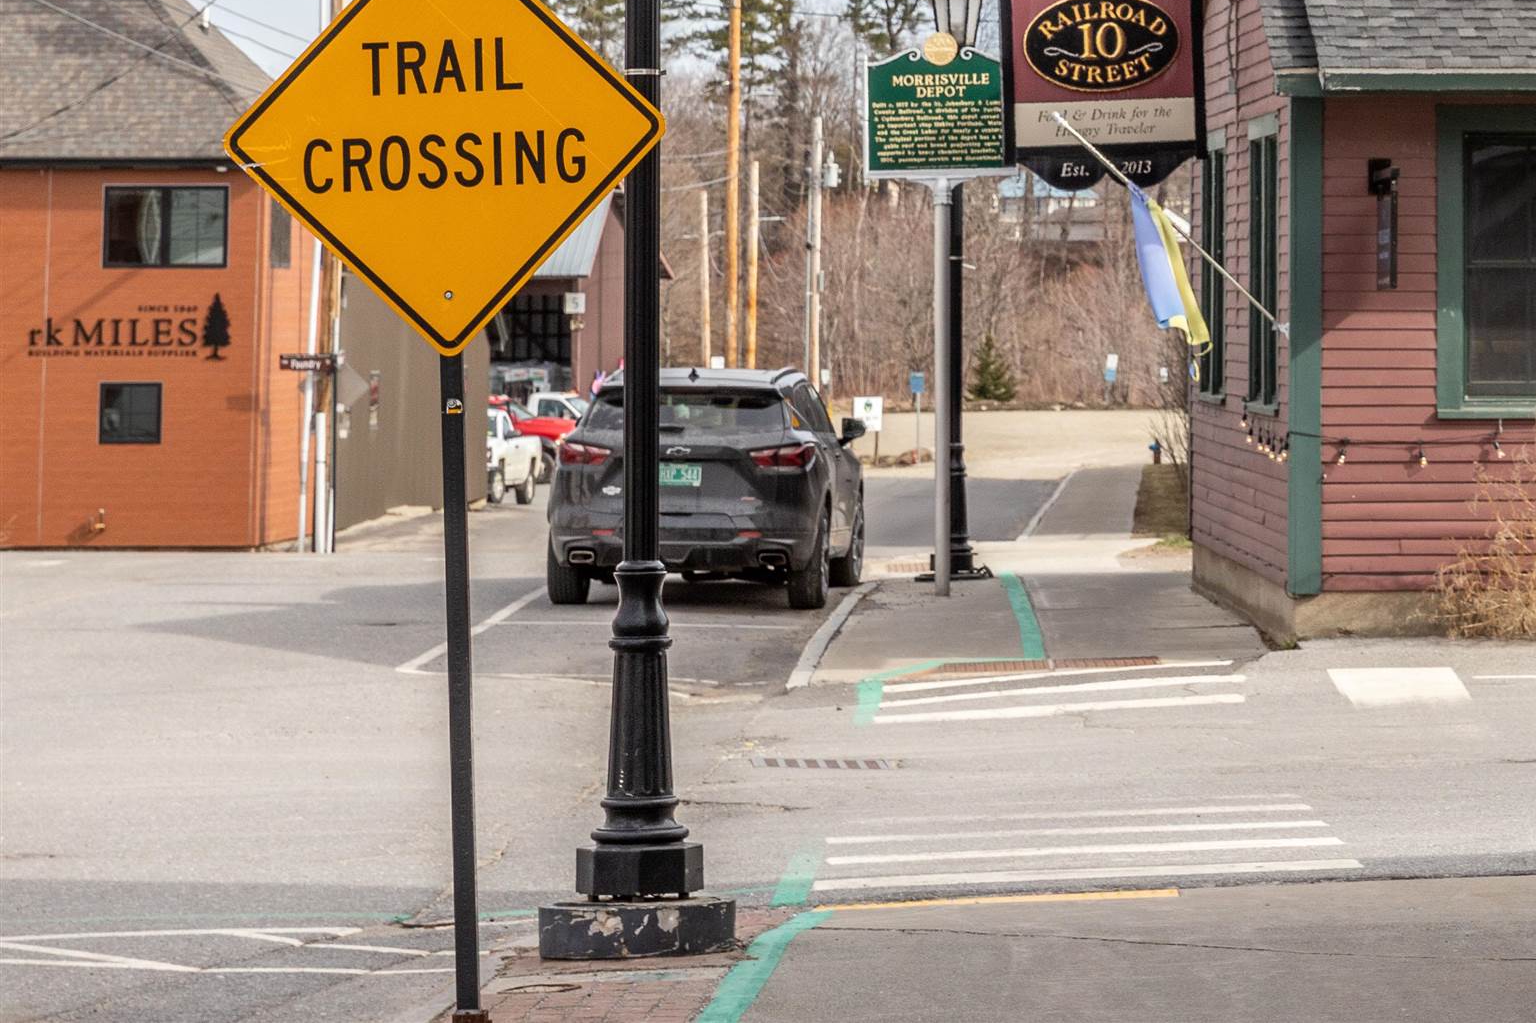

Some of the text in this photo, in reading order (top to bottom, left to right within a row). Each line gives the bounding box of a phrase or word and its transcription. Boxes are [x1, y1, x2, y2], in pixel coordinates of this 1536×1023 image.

[1038, 1, 1167, 40] RAILROAD
[1078, 21, 1127, 59] 10
[362, 36, 524, 97] TRAIL
[892, 72, 990, 87] MORRISVILLE
[1055, 52, 1152, 84] STREET
[916, 85, 967, 98] DEPOT
[1092, 107, 1126, 121] Drink
[1129, 106, 1149, 122] for
[1153, 105, 1172, 119] the
[303, 127, 587, 195] CROSSING
[1060, 160, 1152, 177] Est. 2013
